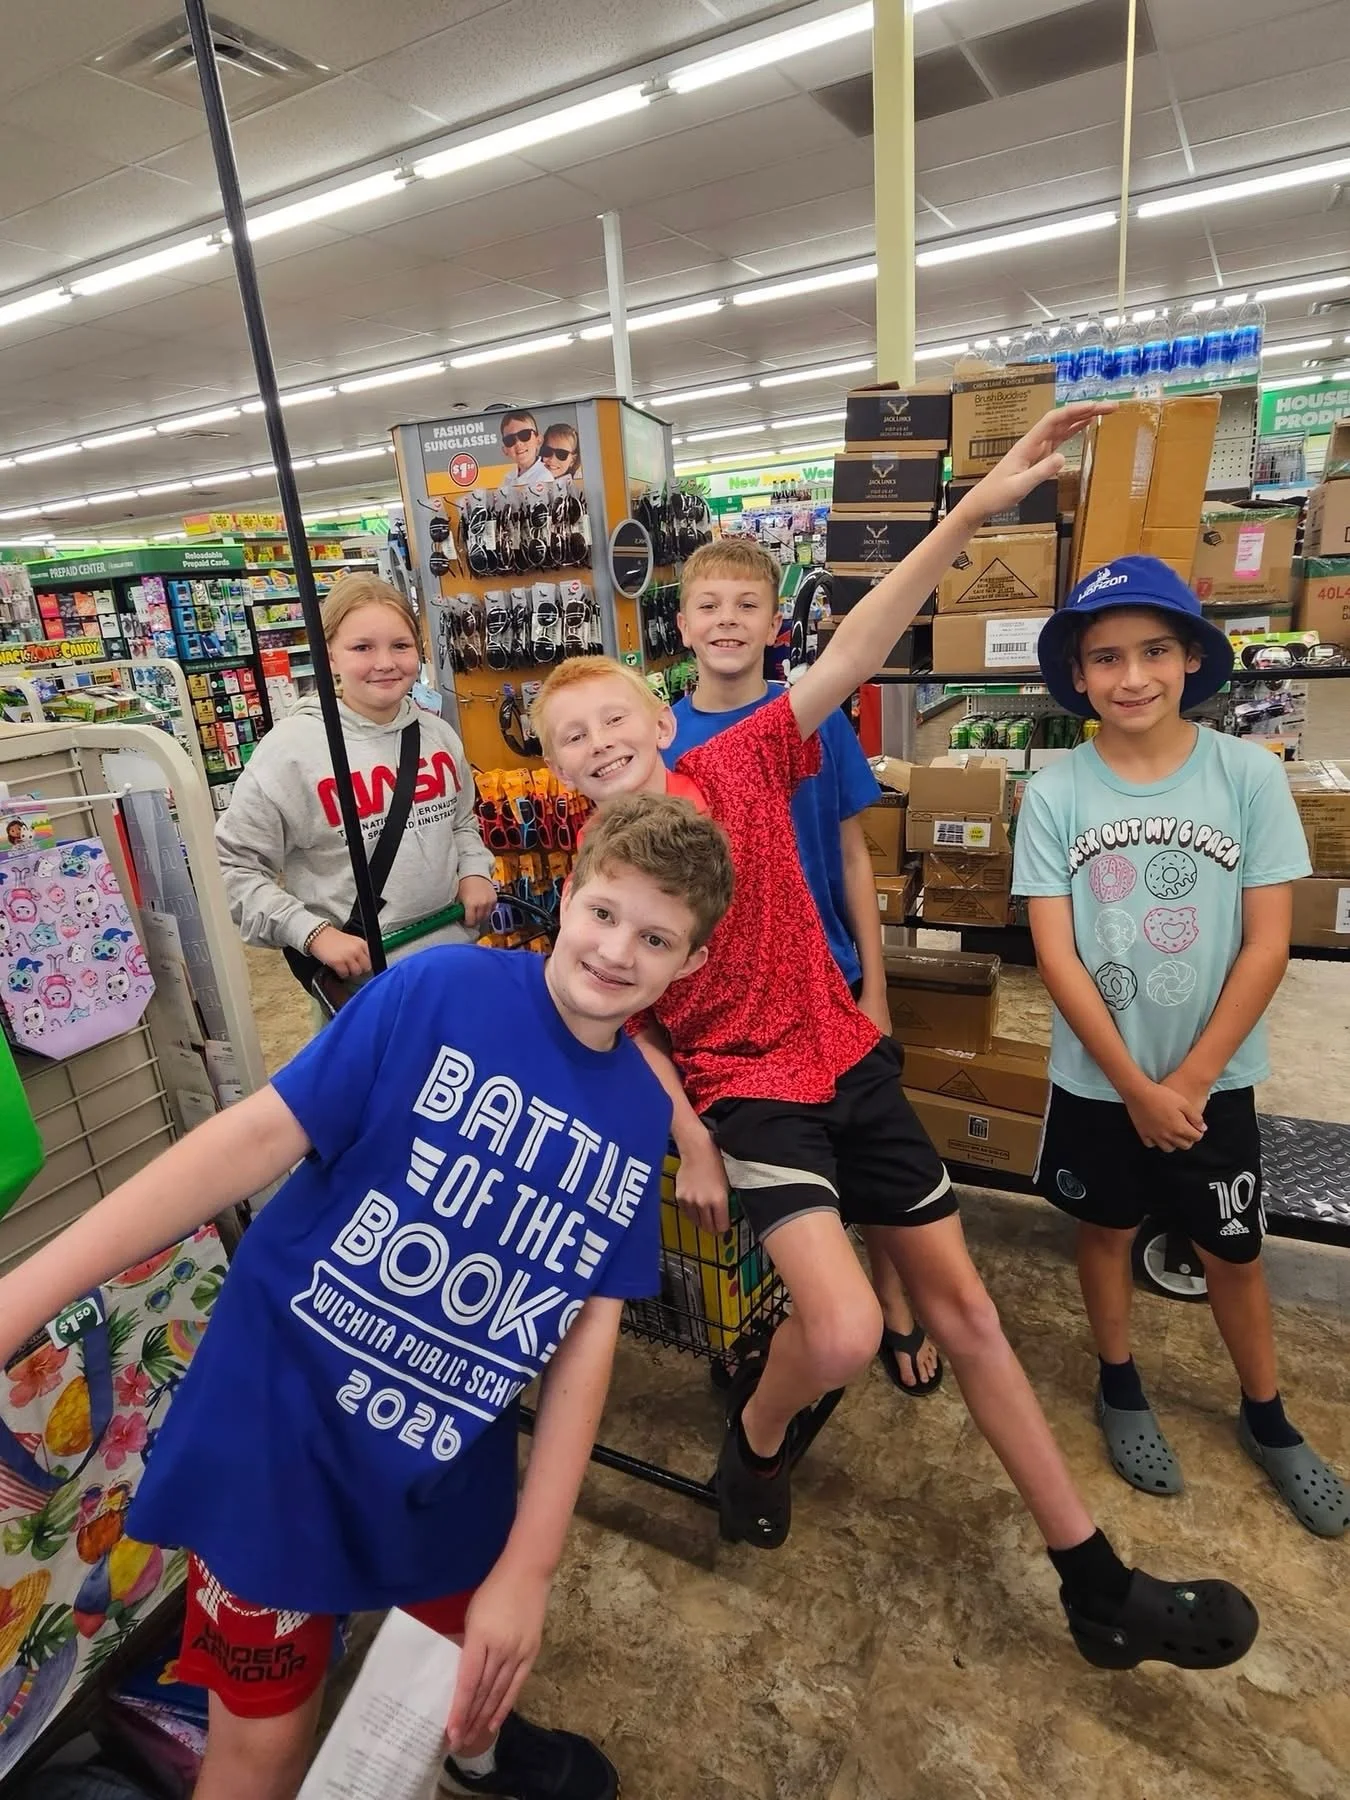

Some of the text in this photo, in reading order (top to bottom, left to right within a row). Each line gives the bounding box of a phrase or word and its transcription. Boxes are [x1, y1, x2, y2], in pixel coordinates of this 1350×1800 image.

[1276, 390, 1350, 413] HOUSE
[433, 422, 484, 438] FASHION
[424, 434, 498, 452] SUNGLASSES
[729, 476, 760, 490] New
[183, 558, 230, 569] Prepaid Cards
[185, 551, 223, 560] Reloadable
[49, 564, 77, 578] PREPAID
[79, 561, 106, 574] CENTER
[25, 643, 60, 663] ZONE
[60, 641, 99, 659] CANDY
[317, 751, 461, 827] NASA
[1101, 818, 1142, 850] OUT
[1145, 817, 1176, 846] MY
[1178, 820, 1193, 848] 6
[1194, 825, 1241, 872] PACK
[412, 1044, 652, 1228] BATTLE
[1209, 1171, 1256, 1219] 10
[433, 1154, 586, 1273] OF THE
[1220, 1226, 1249, 1236] adidas
[313, 1282, 397, 1353] WICHITA
[394, 1333, 468, 1388] PUBLIC
[335, 1369, 462, 1462] 2026
